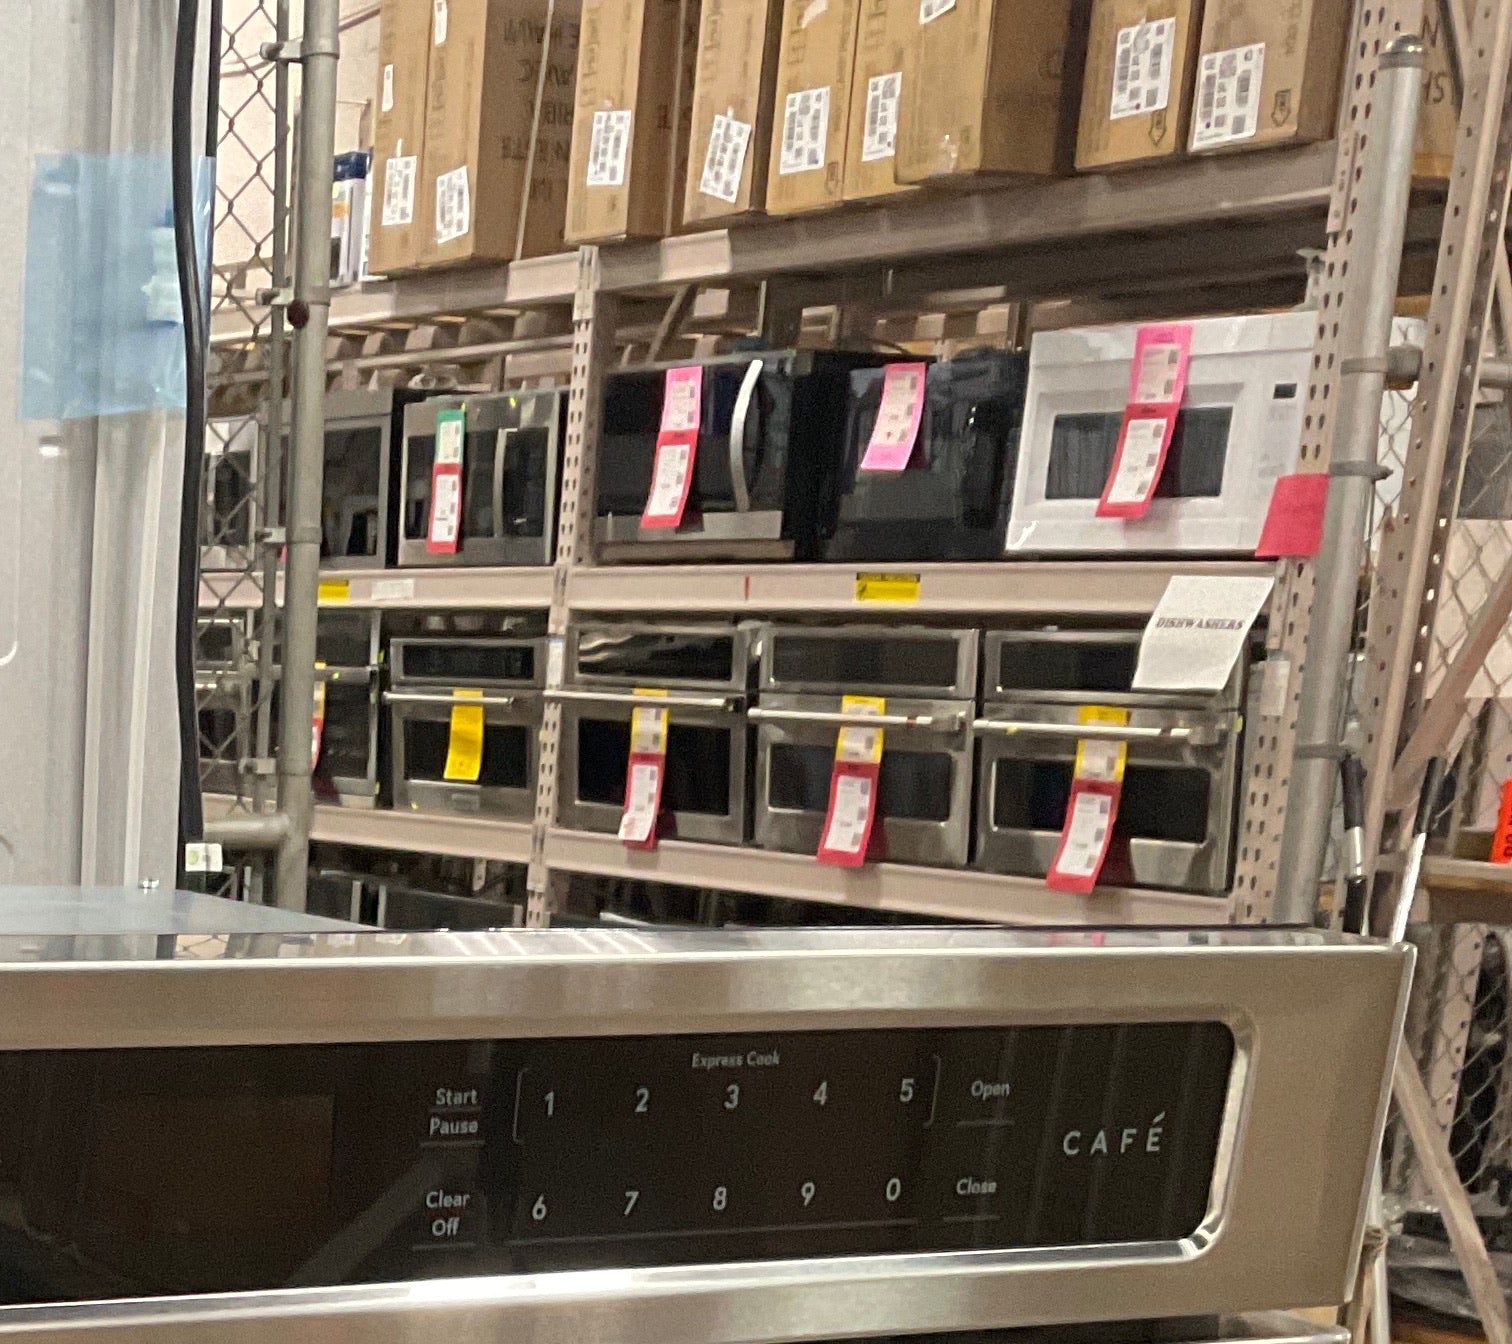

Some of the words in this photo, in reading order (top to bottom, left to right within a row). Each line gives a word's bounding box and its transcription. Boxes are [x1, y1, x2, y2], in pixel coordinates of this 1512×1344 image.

[1156, 617, 1245, 631] DISHWASHERS
[691, 1052, 743, 1070] Express
[746, 1050, 780, 1066] Cook
[435, 1087, 478, 1106] Start
[545, 1091, 555, 1116] 1
[635, 1087, 649, 1113] 2
[724, 1084, 740, 1109] 3
[813, 1081, 828, 1105] 4
[899, 1078, 914, 1103] 5
[970, 1079, 1011, 1101] Open
[429, 1117, 479, 1135] Pause
[1062, 1111, 1165, 1156] CAFÉ
[956, 1177, 997, 1195] Close
[425, 1189, 470, 1209] Clear
[532, 1195, 547, 1220] 6
[624, 1190, 639, 1216] 7
[712, 1186, 727, 1211] 8
[801, 1181, 816, 1206] 9
[431, 1216, 460, 1237] Off
